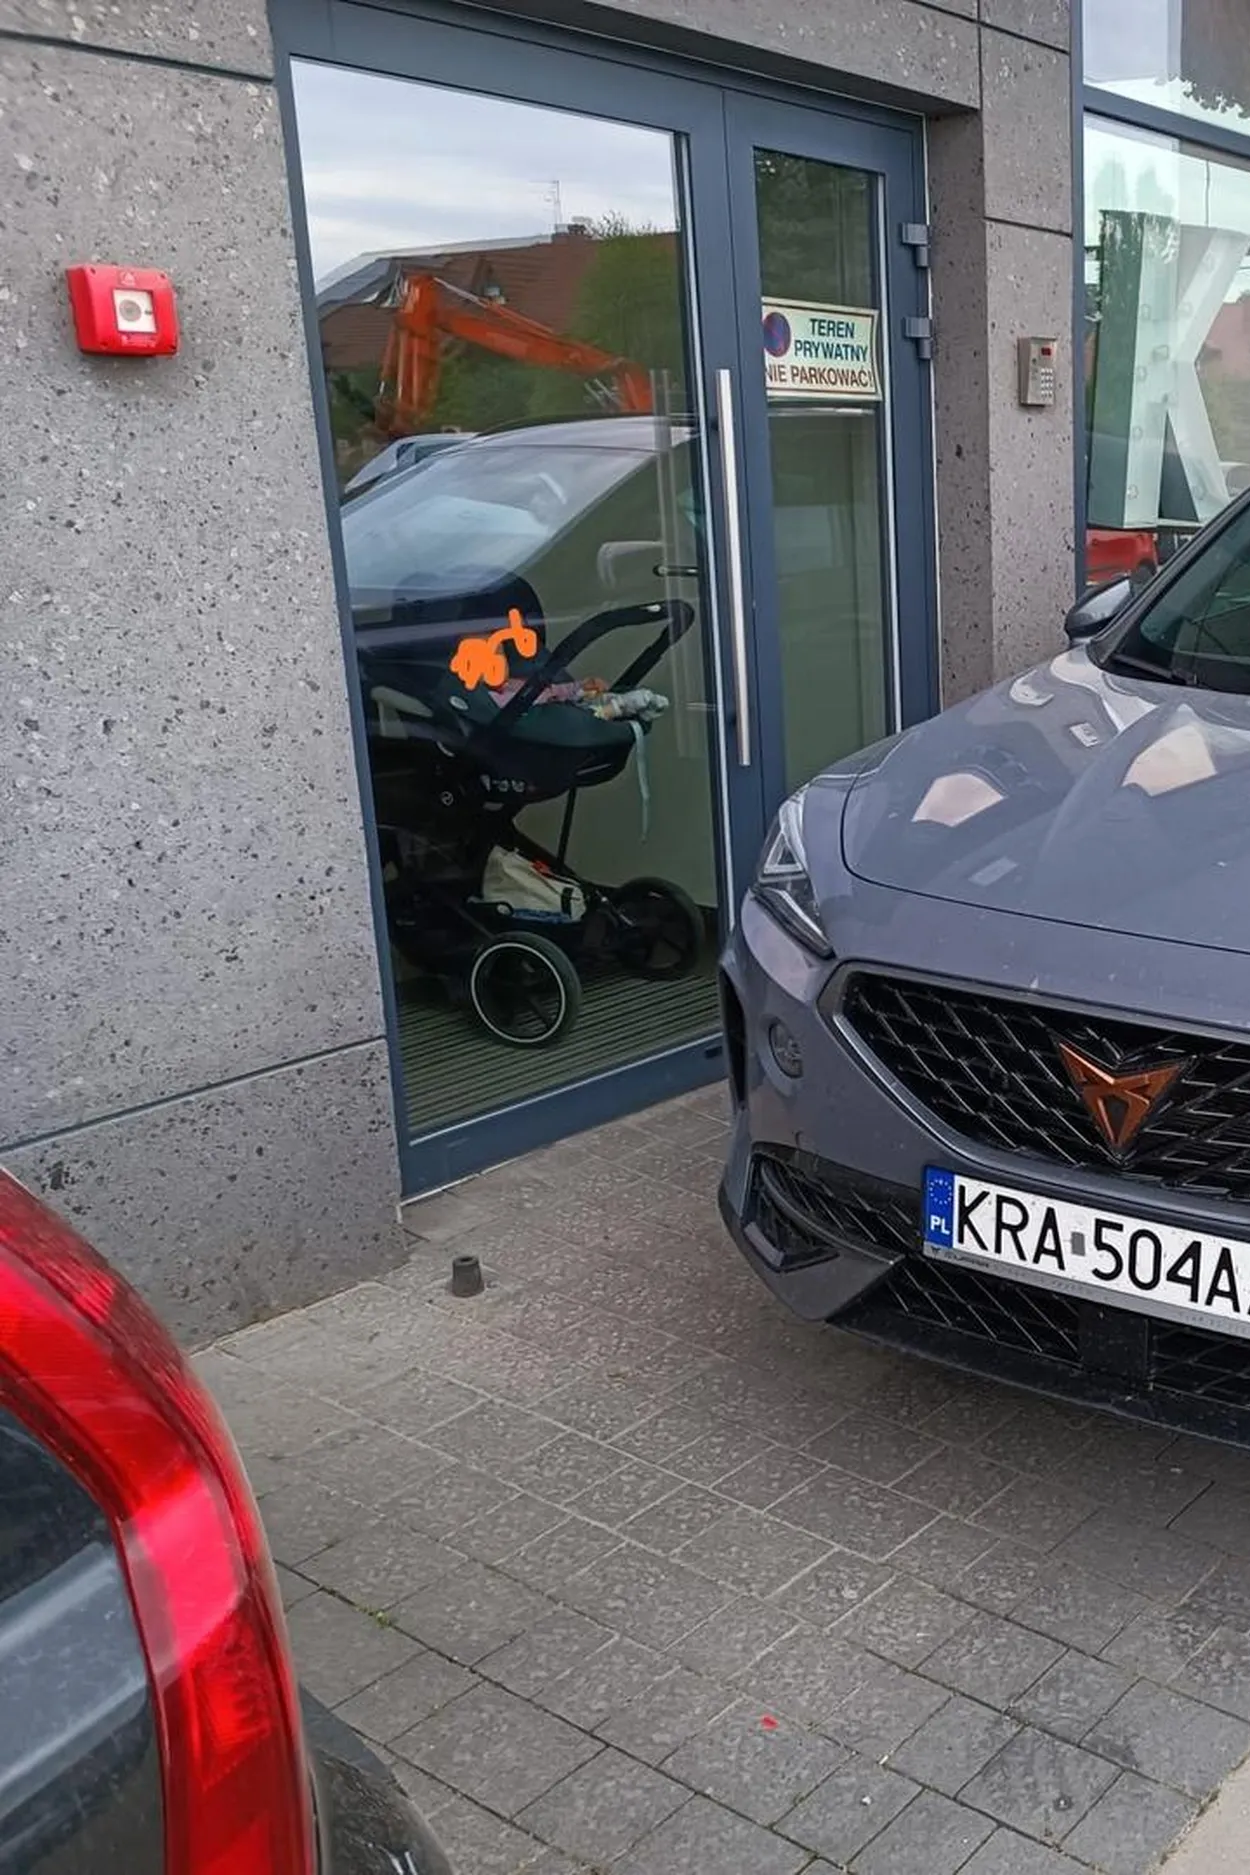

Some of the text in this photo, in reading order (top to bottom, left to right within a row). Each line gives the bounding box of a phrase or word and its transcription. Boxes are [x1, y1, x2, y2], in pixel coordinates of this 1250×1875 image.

[809, 318, 855, 339] TEREN
[794, 340, 868, 362] PRYWATNY
[930, 1215, 950, 1235] PL
[957, 1184, 1066, 1271] KRA
